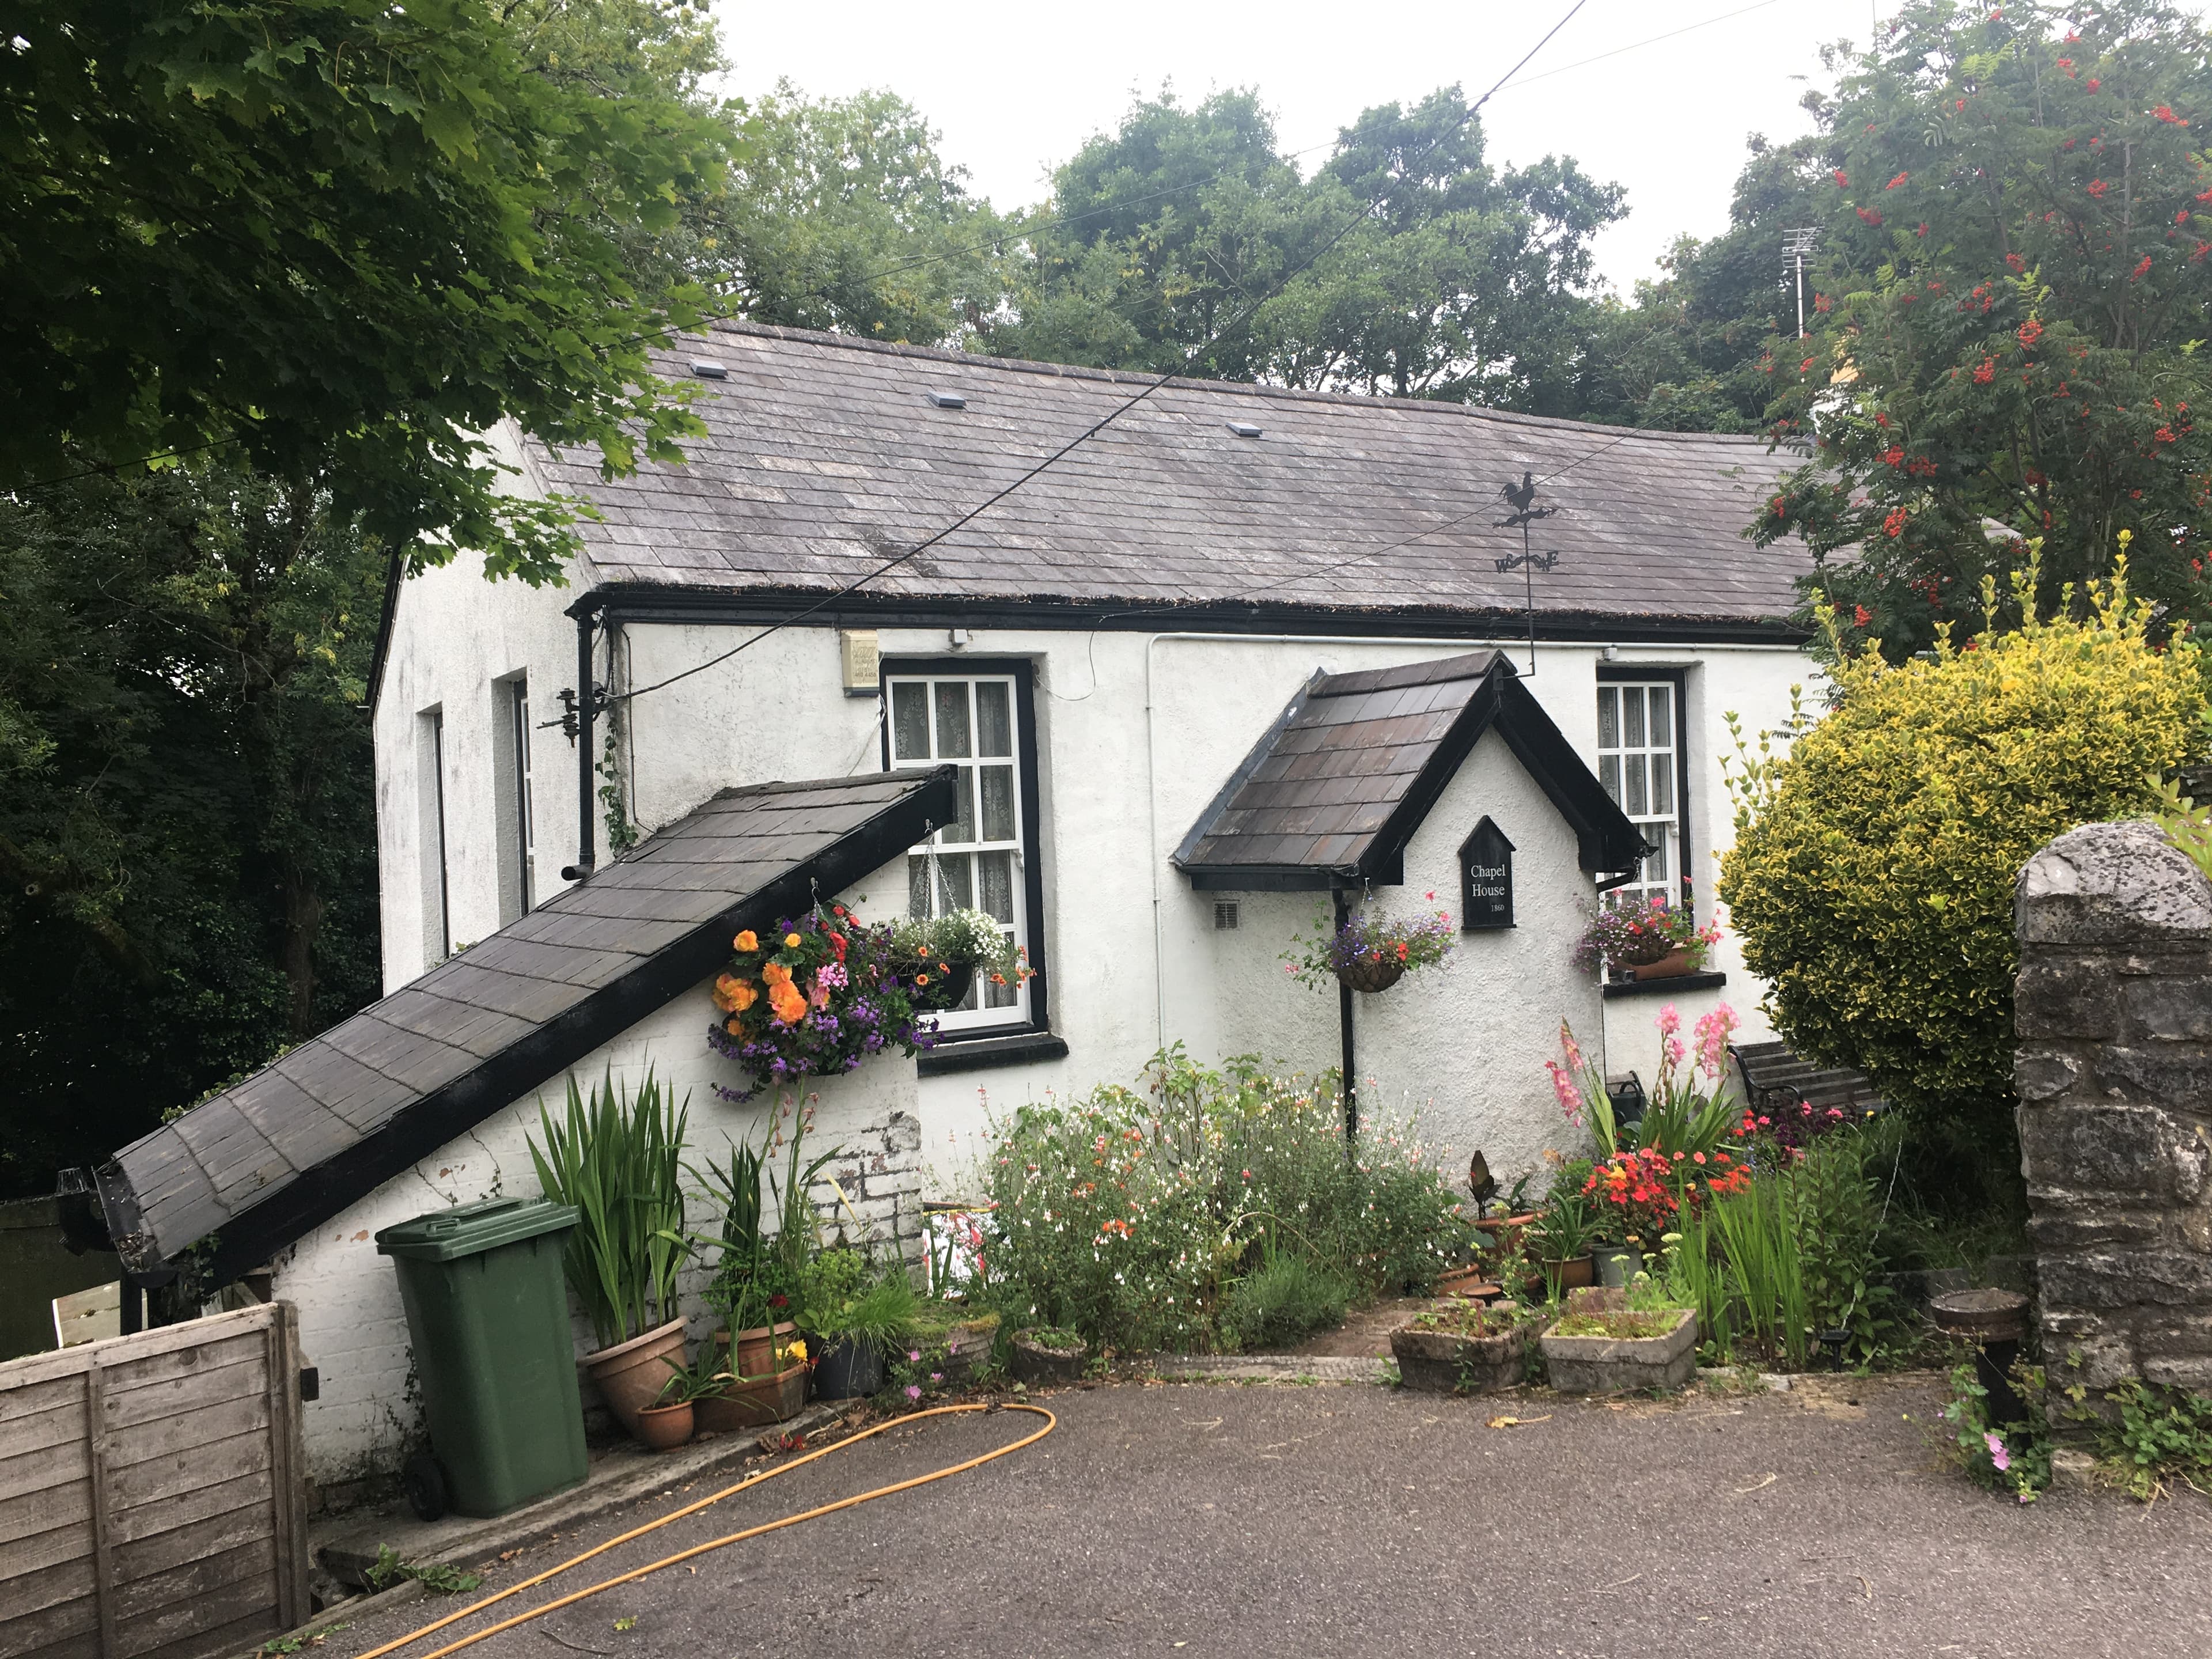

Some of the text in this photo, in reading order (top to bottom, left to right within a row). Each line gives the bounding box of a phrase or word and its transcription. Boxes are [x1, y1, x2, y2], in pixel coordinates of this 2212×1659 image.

[1471, 864, 1506, 880] Chapel
[1472, 884, 1505, 897] House
[1491, 904, 1505, 912] 1860
